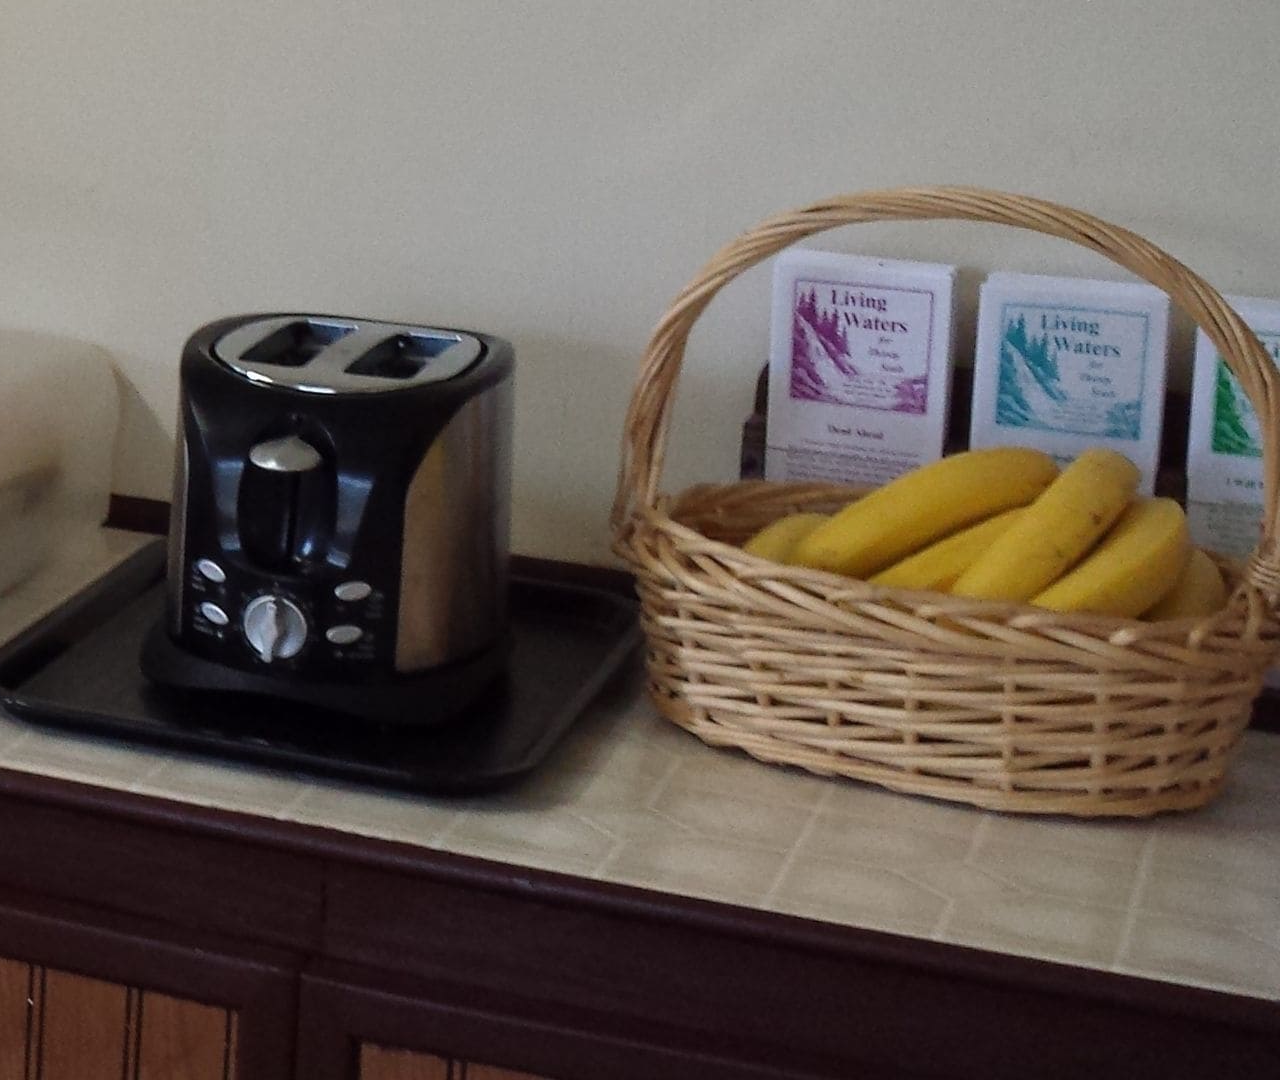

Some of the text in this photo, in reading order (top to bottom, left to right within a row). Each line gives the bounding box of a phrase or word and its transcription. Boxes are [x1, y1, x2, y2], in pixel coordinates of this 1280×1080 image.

[831, 288, 888, 312] Living
[843, 311, 909, 333] Waters
[1040, 313, 1101, 337] Living
[1053, 335, 1121, 358] Waters
